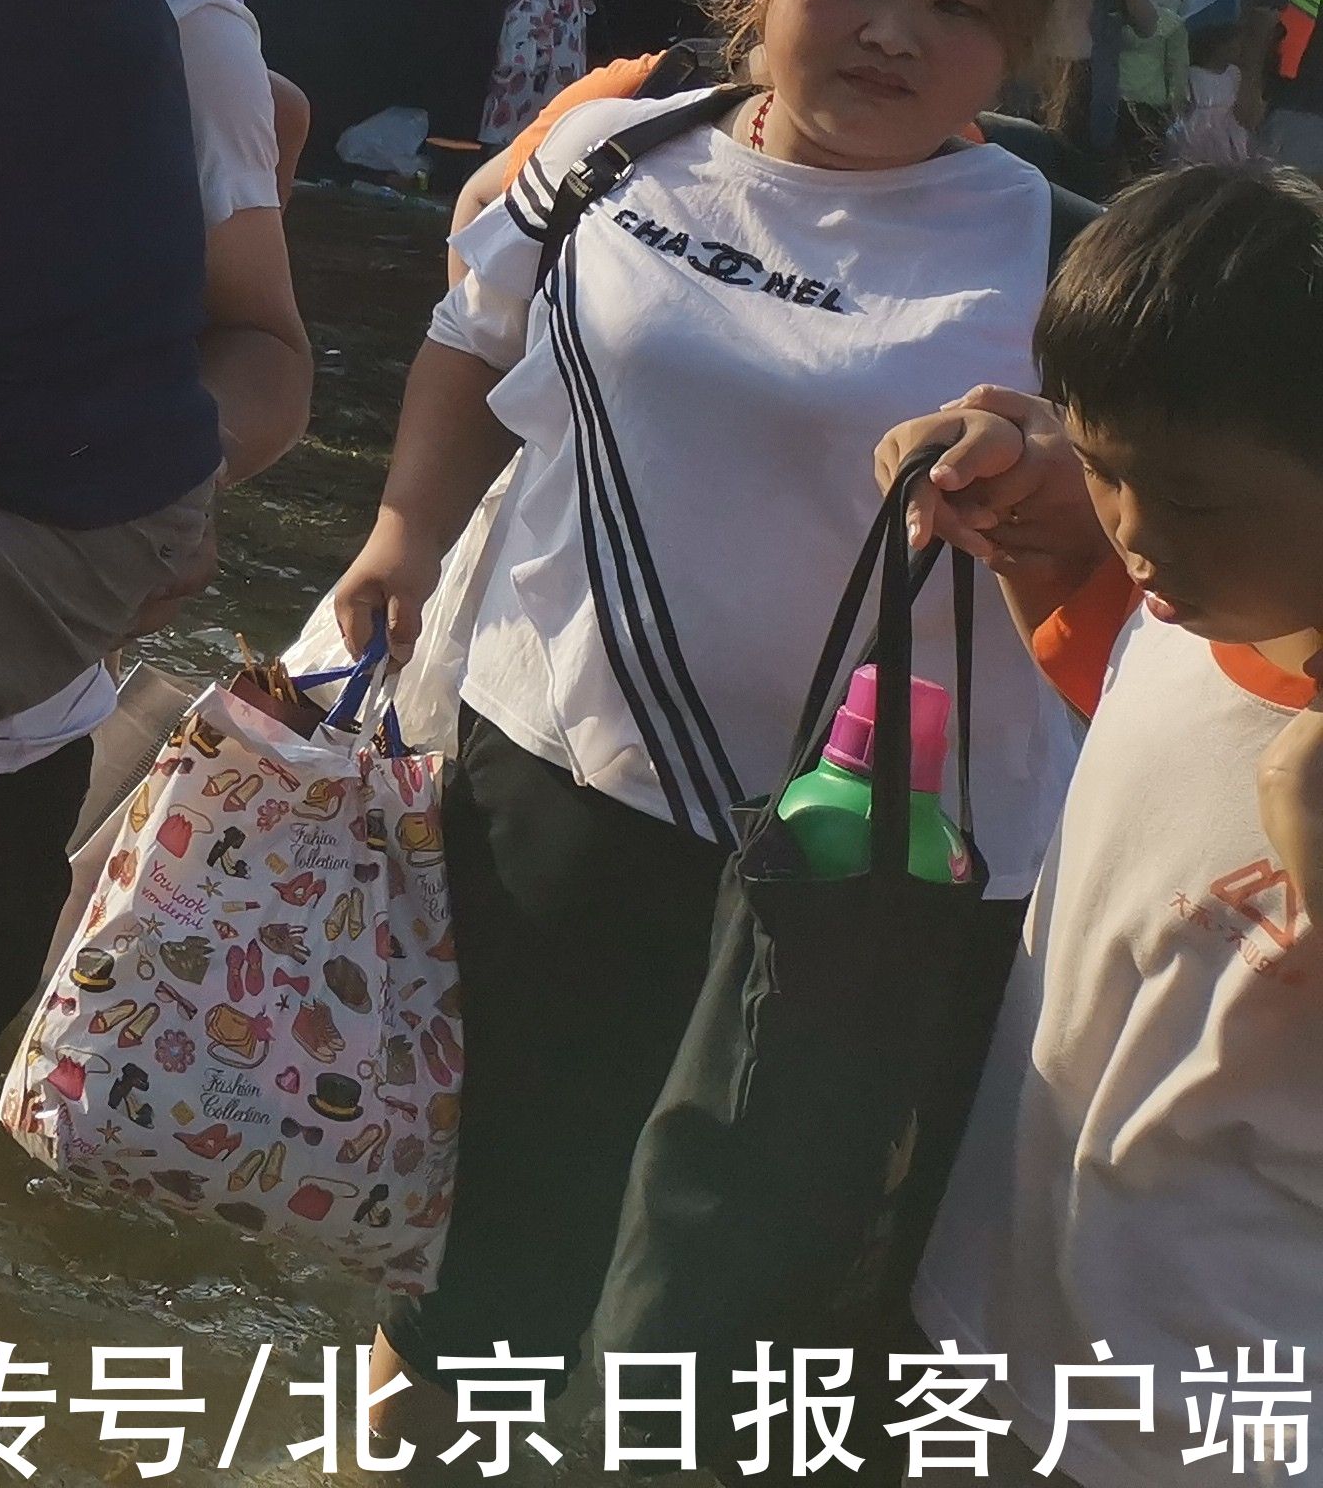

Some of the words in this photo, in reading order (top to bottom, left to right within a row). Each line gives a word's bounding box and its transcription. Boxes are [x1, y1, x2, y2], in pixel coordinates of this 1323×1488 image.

[149, 860, 174, 891] You
[141, 887, 203, 930] wonderful
[201, 1065, 263, 1099] Fashion
[199, 1091, 273, 1125] Collection
